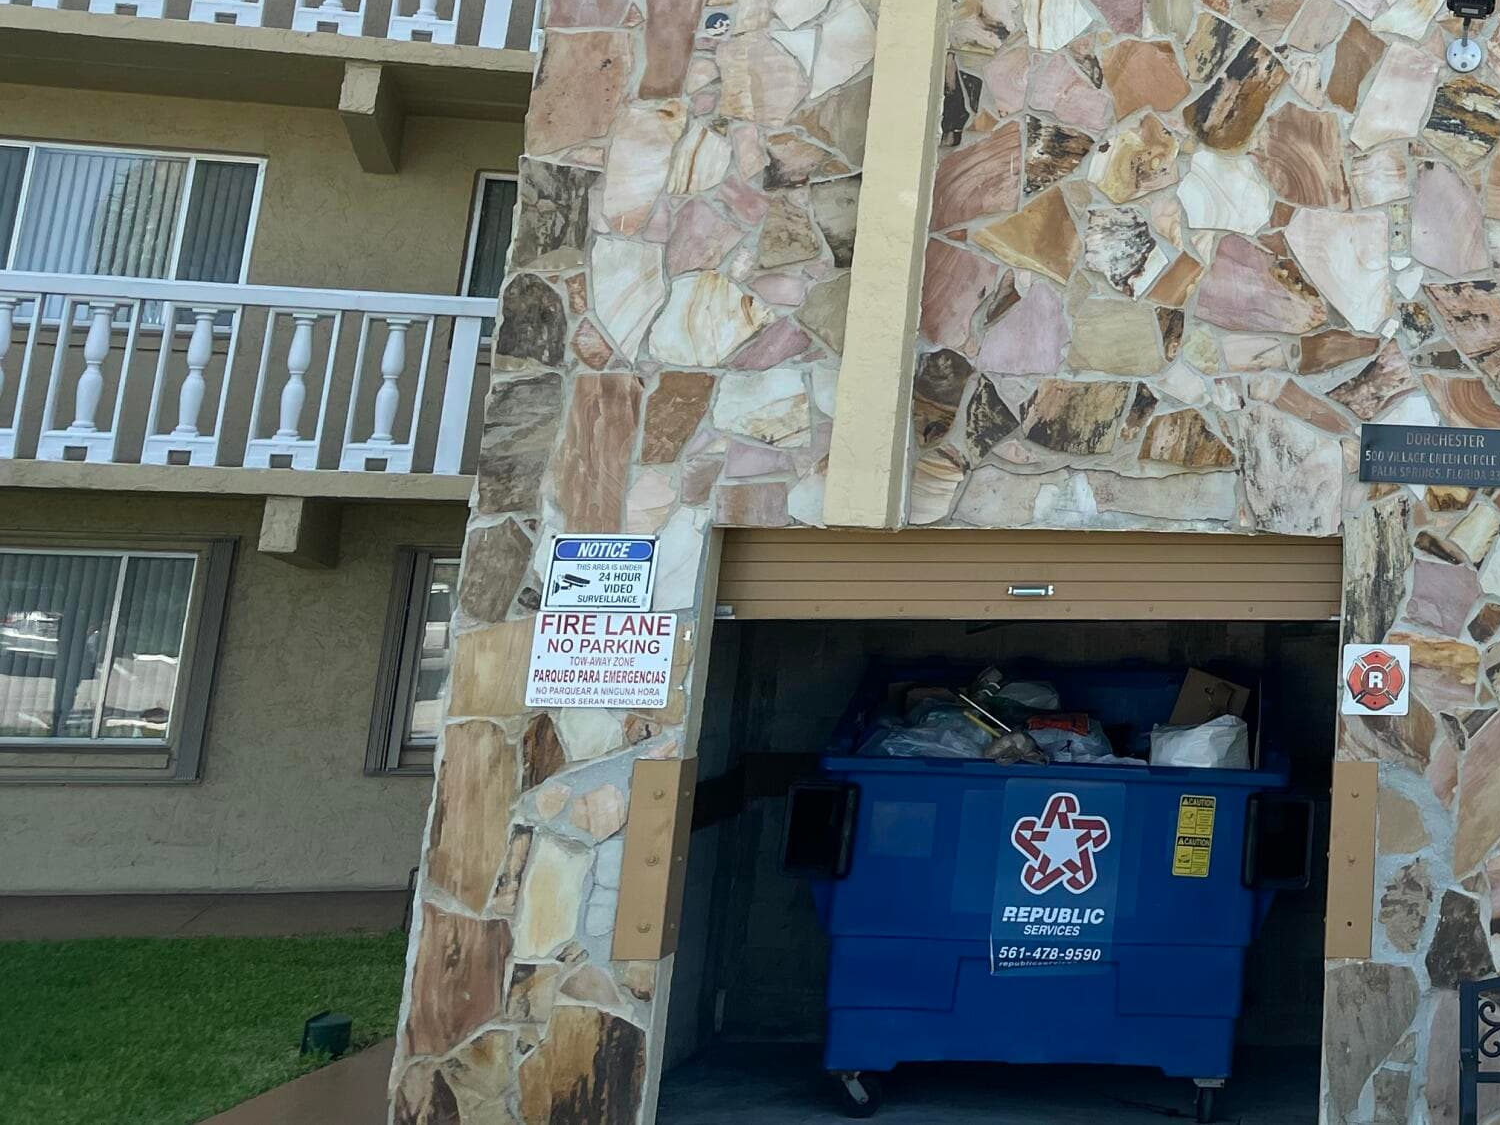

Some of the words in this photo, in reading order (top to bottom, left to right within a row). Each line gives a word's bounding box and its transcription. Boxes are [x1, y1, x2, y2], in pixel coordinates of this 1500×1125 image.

[1406, 432, 1485, 448] DORCHESTER
[1365, 450, 1385, 461] 500
[1388, 451, 1426, 463] VILLAGE
[1463, 454, 1497, 466] CIRCLE
[1371, 465, 1397, 476] PALM
[1446, 468, 1486, 480] FLORIDA
[576, 542, 632, 558] NOTICE
[599, 572, 611, 581] 24
[613, 572, 642, 582] HOUR
[603, 584, 633, 593] VIDEO
[577, 595, 638, 604] SURVEILLANCE
[540, 614, 598, 635] FIRE
[604, 615, 672, 636] LANE
[547, 638, 574, 653] NO
[579, 639, 660, 655] PARKING
[570, 656, 612, 667] TOW-AWAY
[612, 657, 636, 667] ZONE
[533, 669, 576, 683] PARQUEO
[577, 670, 600, 683] PARA
[602, 670, 667, 684] EMERGENCIAS
[1368, 671, 1383, 688] R
[535, 686, 548, 694] NO
[549, 686, 592, 695] PARQUEAR
[593, 687, 599, 695] A
[600, 687, 636, 695] NINGUNA
[637, 687, 660, 695] HORA
[530, 697, 576, 705] VEHICULOS
[607, 698, 665, 706] REMOLCADOS
[1188, 798, 1215, 808] CAUTION
[1184, 837, 1211, 848] CAUTION
[1002, 906, 1105, 924] REPUBLIC
[1023, 924, 1081, 936] SERVICES
[998, 946, 1102, 961] 561-478-9590
